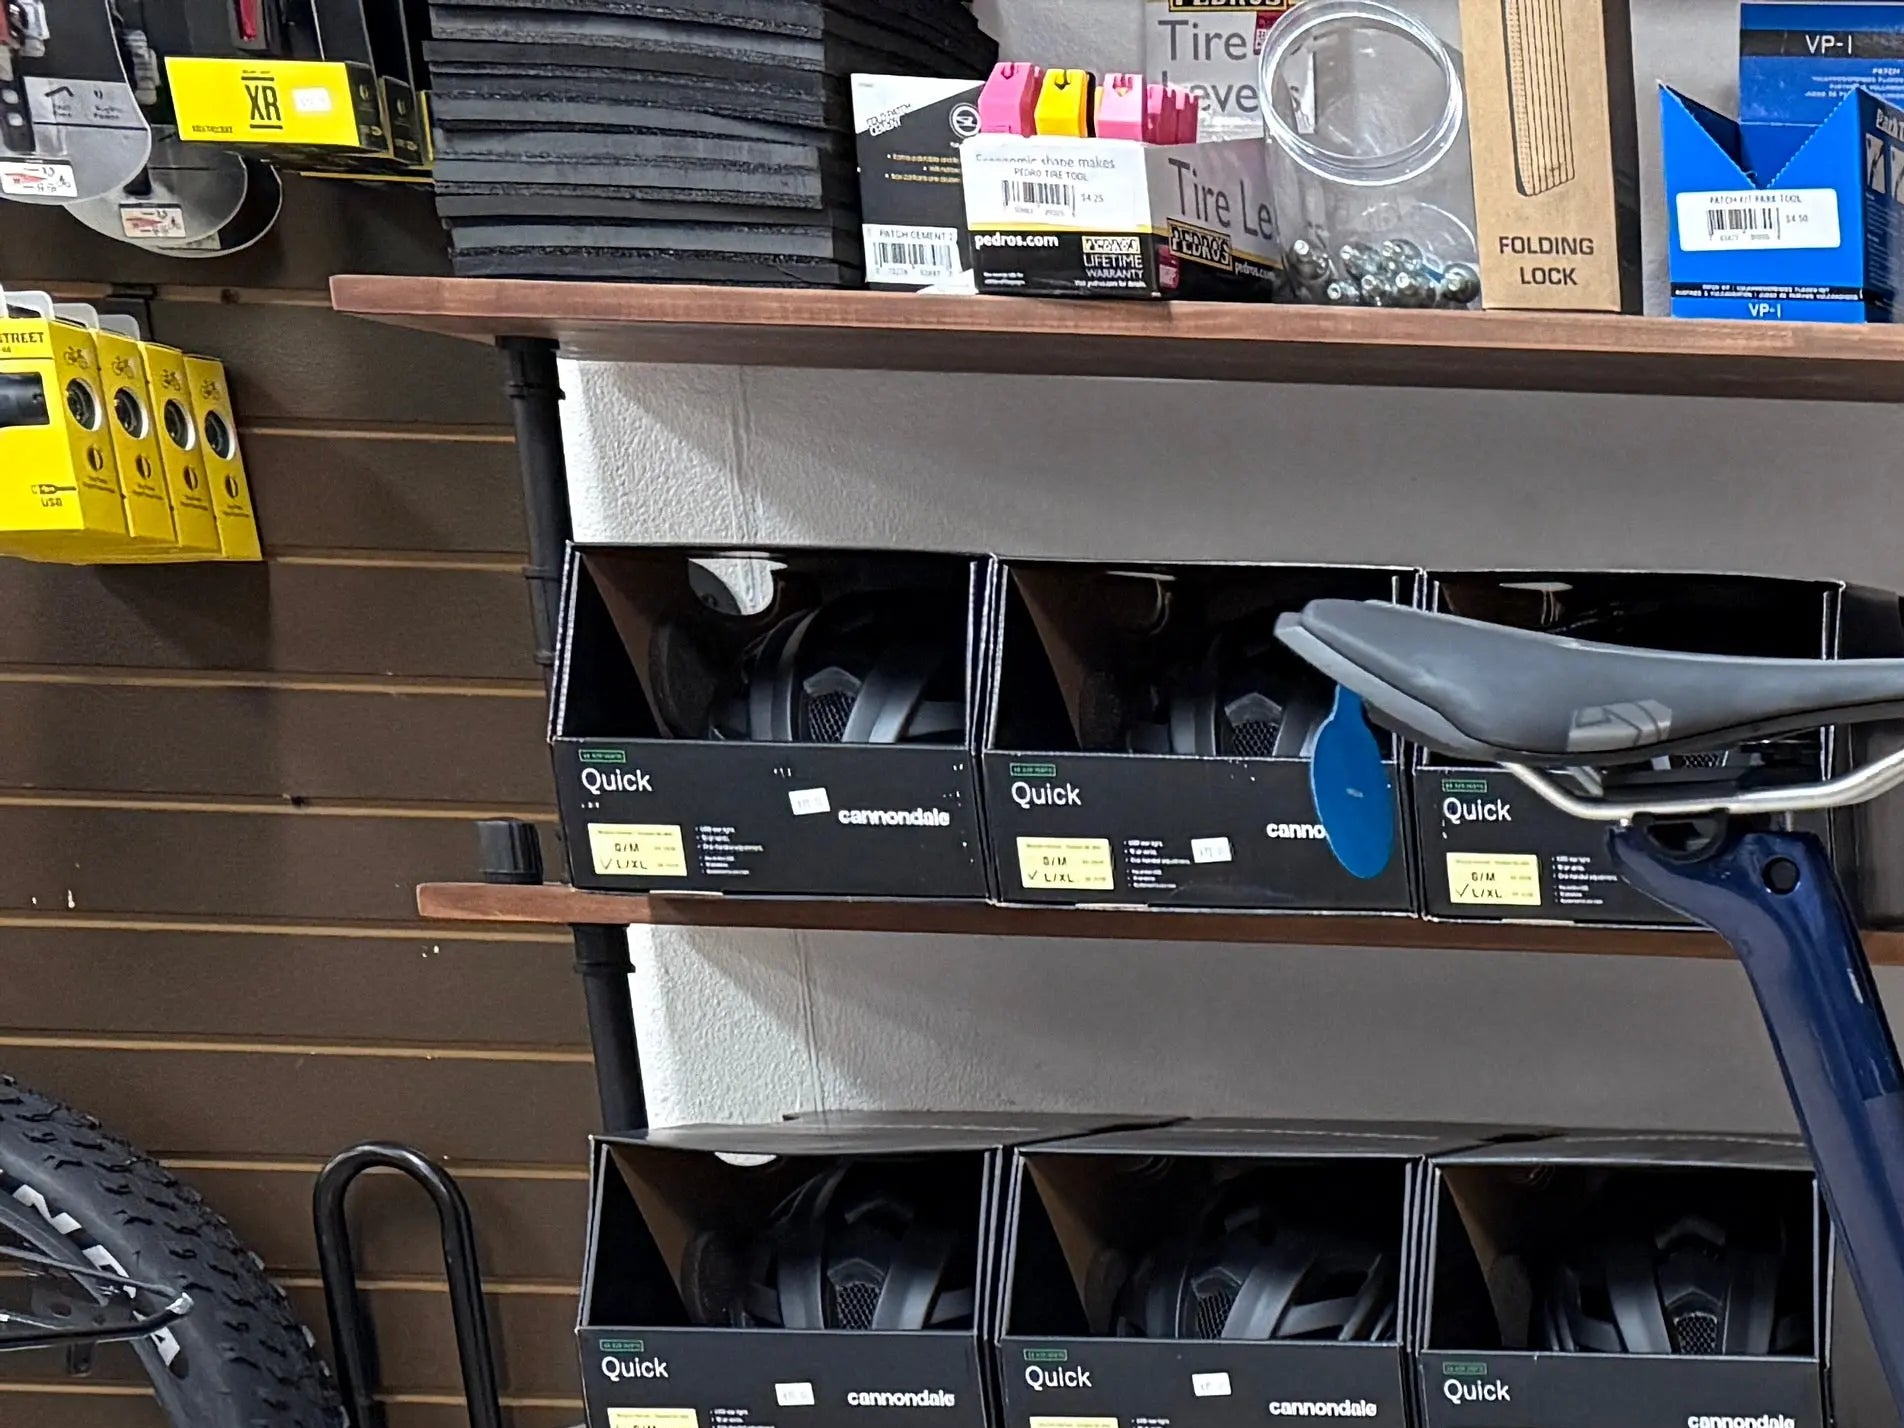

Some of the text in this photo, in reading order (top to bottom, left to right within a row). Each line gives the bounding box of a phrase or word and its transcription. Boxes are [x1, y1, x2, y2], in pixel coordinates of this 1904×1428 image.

[1158, 20, 1248, 61] Tire
[245, 84, 281, 122] XR
[1078, 157, 1116, 169] makes
[1168, 157, 1231, 228] Tire
[975, 233, 1059, 250] pedros.com
[1499, 236, 1594, 256] FOLDING
[1083, 254, 1143, 268] LIFETIME
[1086, 268, 1144, 279] WARRANTY
[1520, 264, 1578, 286] LOCK
[581, 768, 653, 795] Quick
[1011, 781, 1082, 809] Quick
[838, 807, 951, 827] cannondale
[1443, 796, 1512, 823] Quick
[1266, 823, 1326, 840] canno
[602, 1356, 669, 1382] Quick
[1025, 1365, 1093, 1392] Quick
[847, 1389, 956, 1408] cannondale
[1443, 1378, 1511, 1405] Quick
[1268, 1399, 1378, 1418] cannondale
